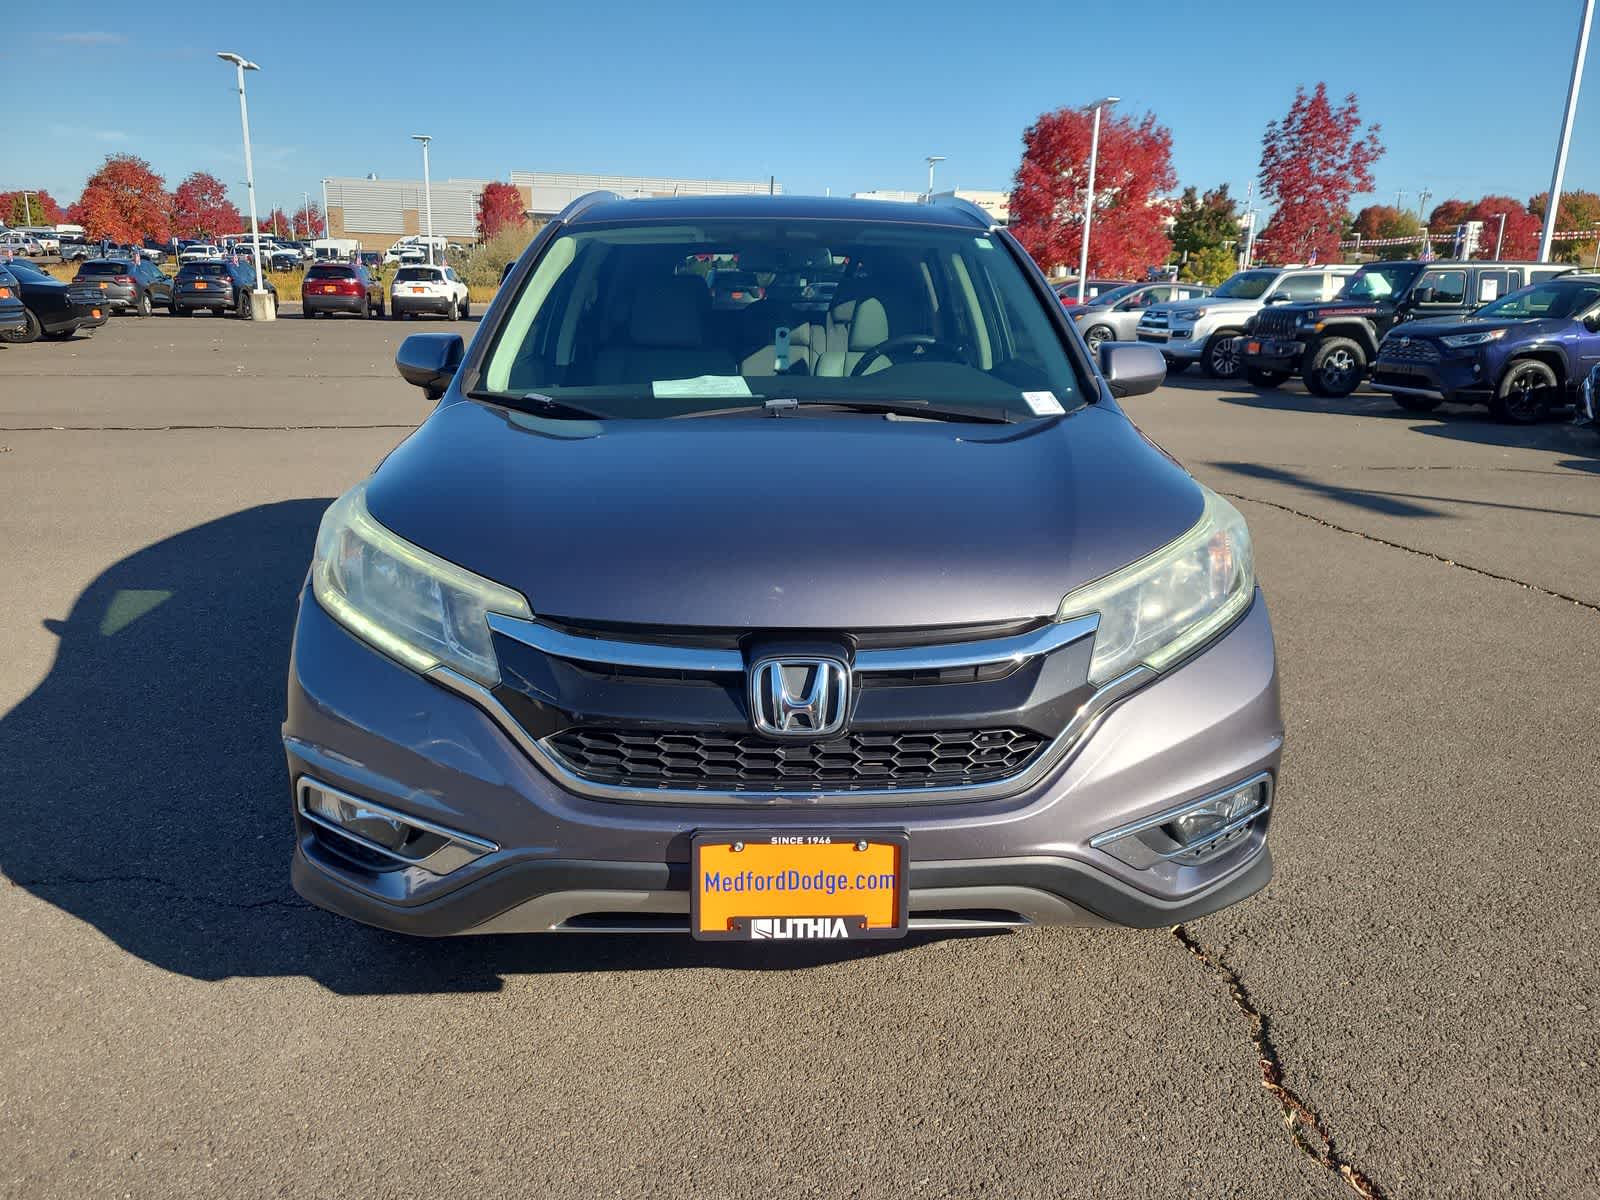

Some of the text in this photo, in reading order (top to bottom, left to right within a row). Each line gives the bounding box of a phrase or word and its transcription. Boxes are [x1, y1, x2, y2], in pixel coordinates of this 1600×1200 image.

[771, 836, 832, 845] SINCE 1946
[704, 870, 896, 895] MedfordDodge.com
[773, 917, 848, 939] LITHIA
